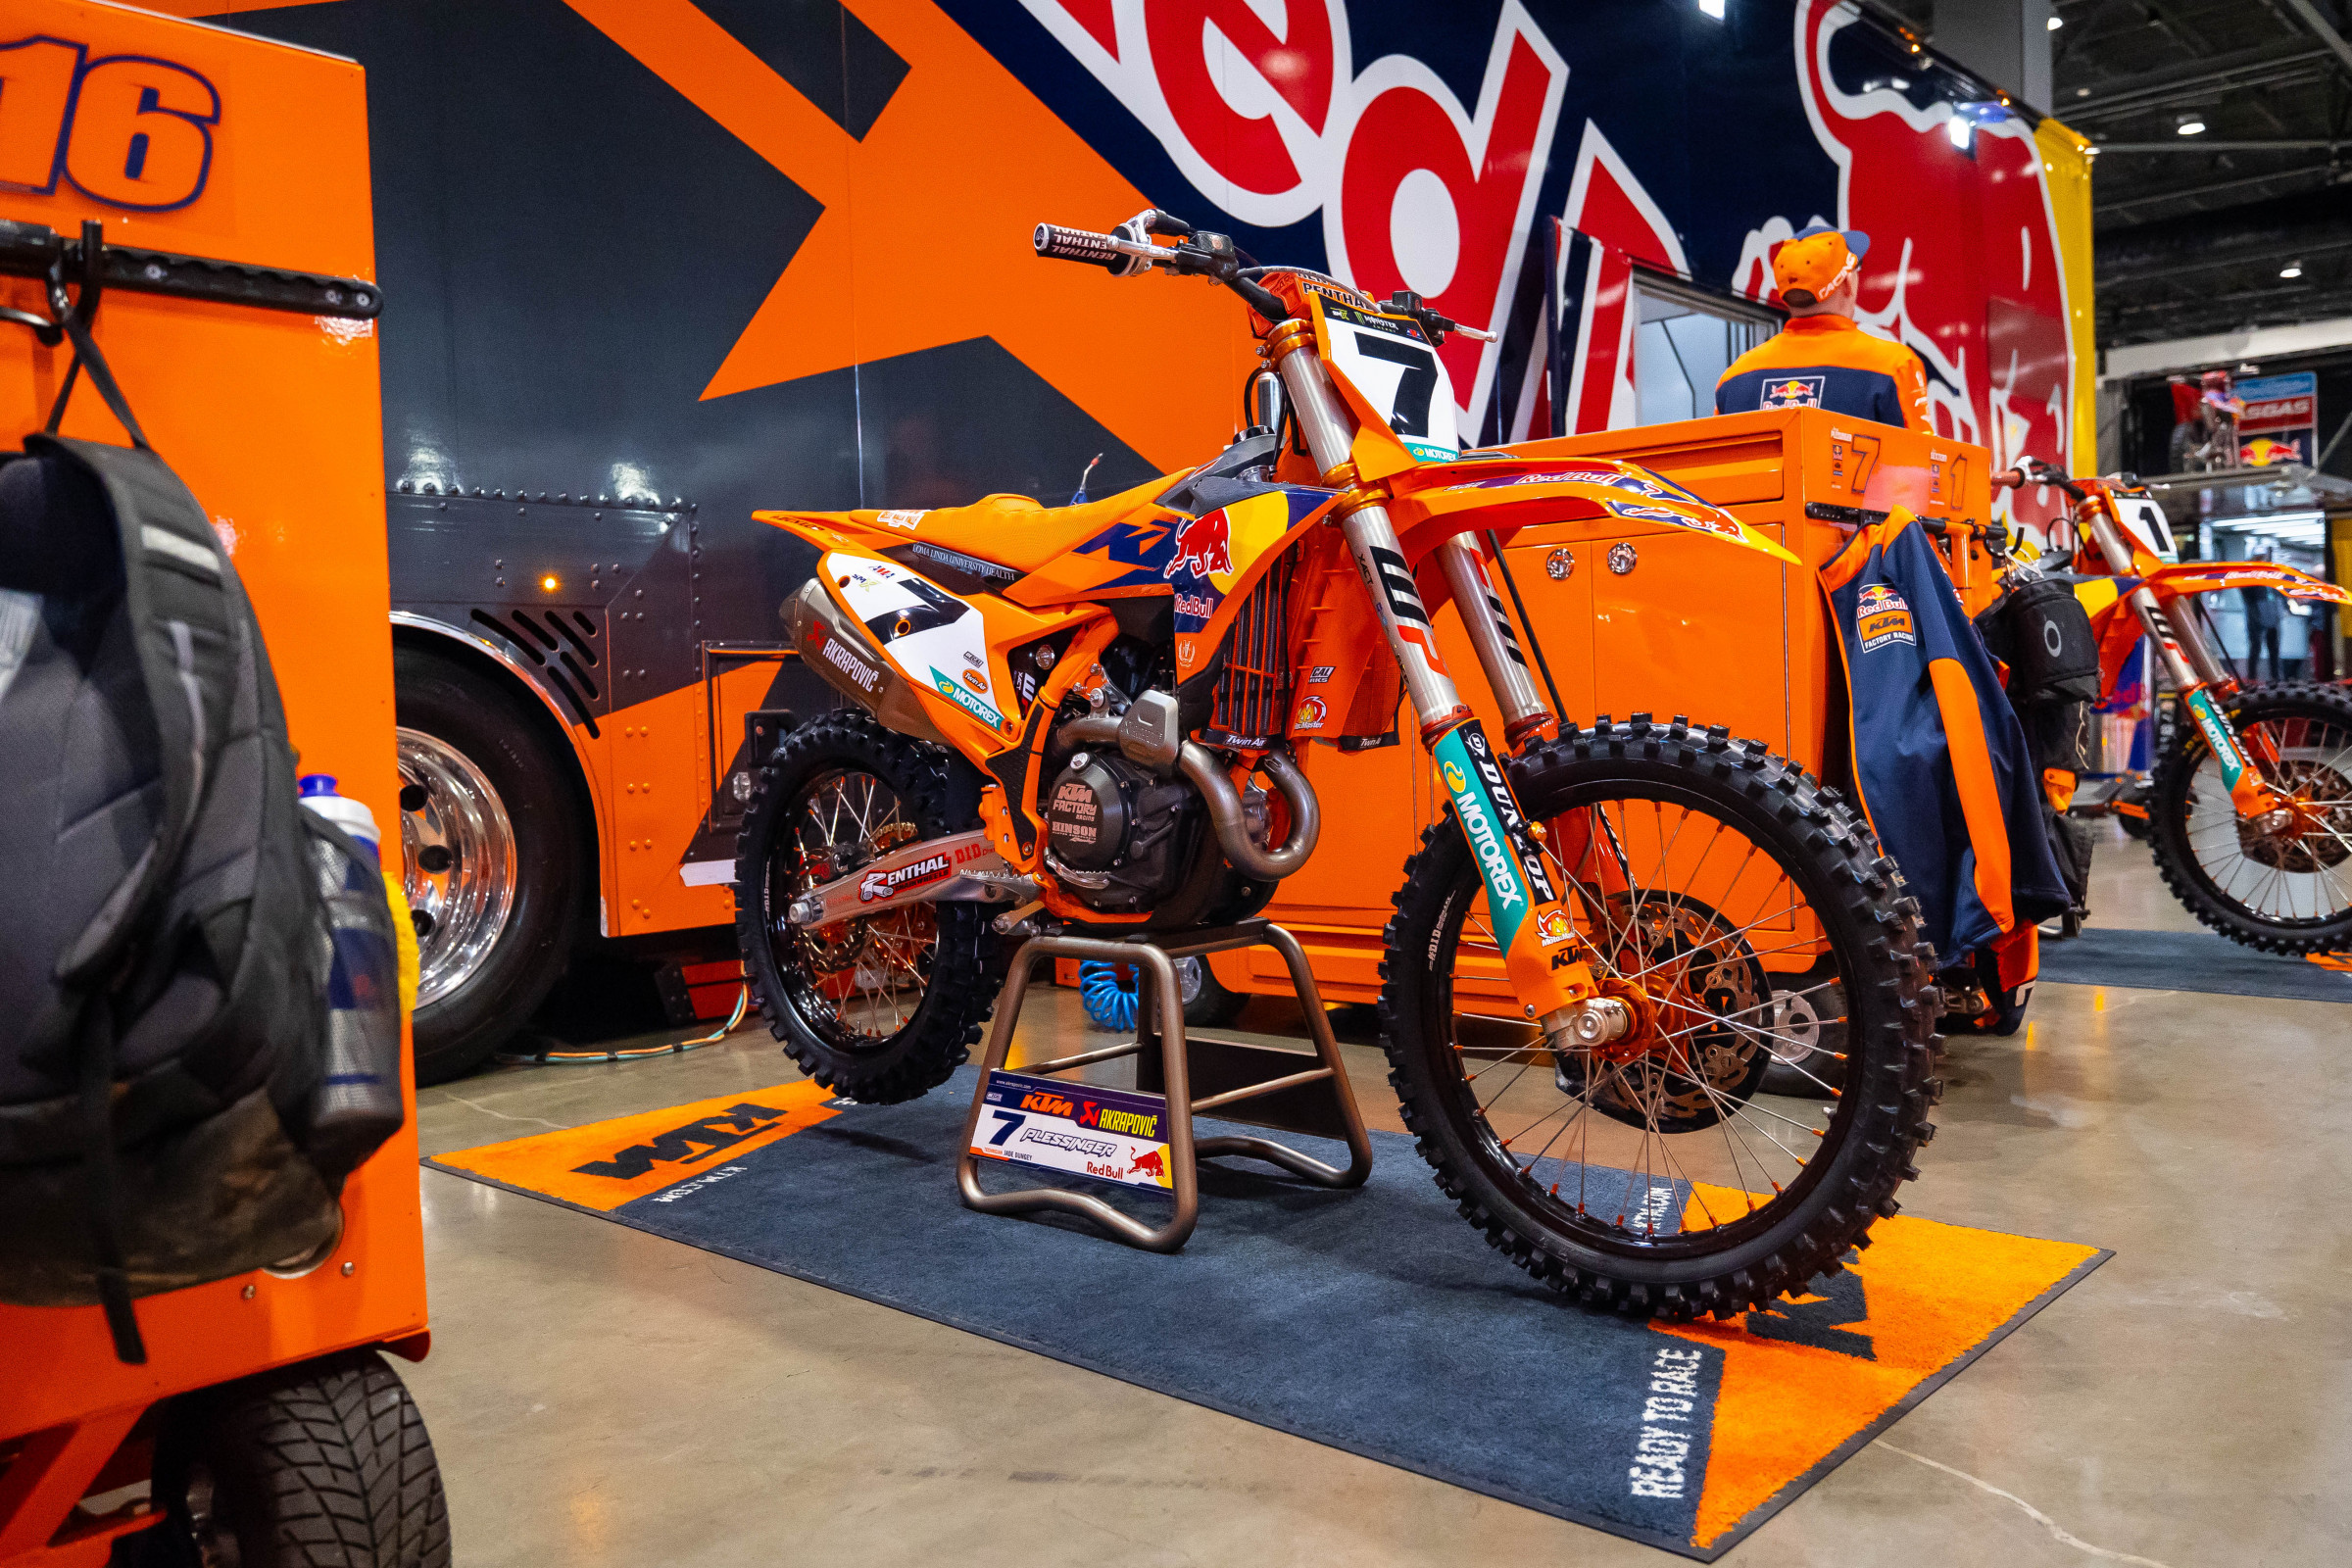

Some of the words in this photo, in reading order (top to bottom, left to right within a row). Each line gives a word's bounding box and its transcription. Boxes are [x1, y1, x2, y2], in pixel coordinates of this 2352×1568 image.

[1019, 0, 1570, 451] ed
[1052, 245, 1117, 261] RENTHAL
[1353, 330, 1438, 438] 7
[1851, 433, 1881, 494] 7
[1950, 454, 1968, 511] 1
[2138, 506, 2170, 552] 1
[912, 544, 930, 557] LOMA
[930, 549, 949, 563] LINDA
[949, 554, 986, 574] UNIVERSITY
[985, 565, 1015, 581] HEALTH
[1356, 554, 1374, 585] XACT
[865, 577, 970, 646] 7
[1175, 594, 1194, 615] Red
[1193, 596, 1214, 618] Bull
[1857, 601, 1883, 618] Red
[1869, 614, 1905, 633] KTM
[1864, 634, 1891, 649] FACTORY
[1893, 631, 1914, 642] RACING
[822, 637, 879, 693] AKRAPOVIČ
[964, 671, 979, 686] Twin
[976, 682, 987, 691] Air
[953, 687, 1000, 727] MOTOREX
[1227, 735, 1251, 746] Twin
[1250, 737, 1267, 747] Air
[2201, 717, 2240, 771] MOTOREX
[1053, 799, 1097, 816] FACTORY
[1057, 783, 1093, 803] KTM
[1052, 821, 1097, 837] HINSON
[955, 844, 982, 863] DID
[1456, 792, 1522, 910] MOTOREX
[860, 856, 949, 901] RENTHAL
[1019, 1091, 1074, 1117] KTM
[988, 1109, 1026, 1146] 7
[1099, 1108, 1157, 1138] AKRAPOVIČ
[567, 1102, 789, 1180] KTM
[1020, 1127, 1118, 1157] PLESSINGER
[1086, 1161, 1105, 1176] Red
[1105, 1164, 1124, 1180] Bull
[1648, 1348, 1702, 1397] RACE
[1642, 1396, 1693, 1422] TO
[1628, 1425, 1693, 1498] READY
